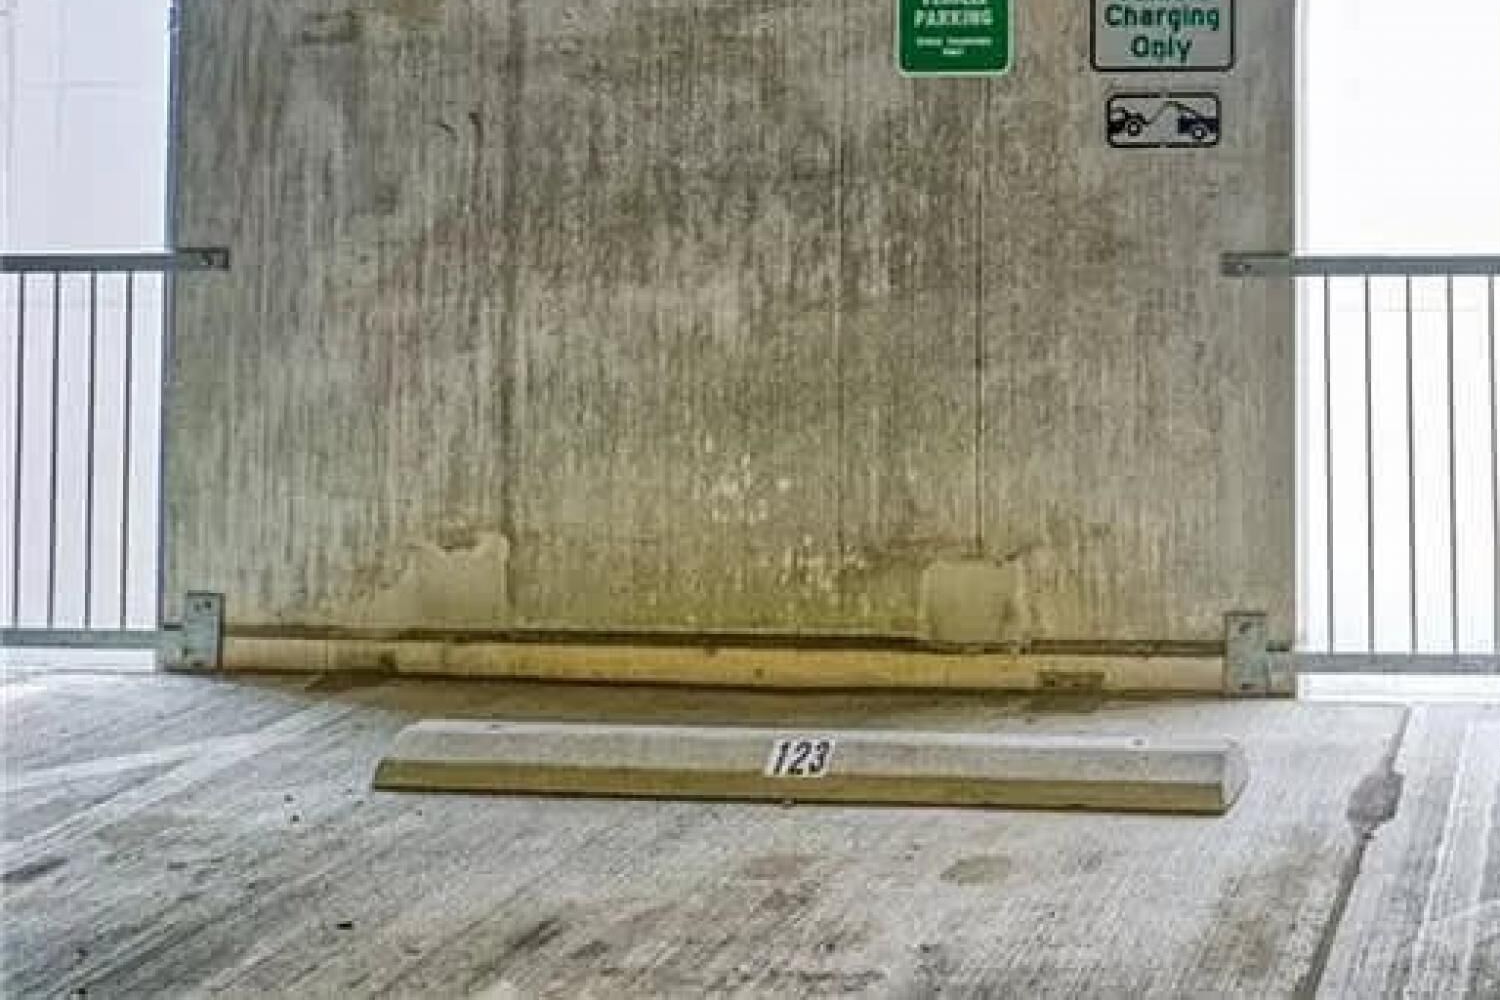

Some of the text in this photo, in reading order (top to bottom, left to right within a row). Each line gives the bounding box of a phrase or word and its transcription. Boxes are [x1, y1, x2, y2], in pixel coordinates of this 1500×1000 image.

[914, 9, 993, 26] PARKING
[1104, 5, 1220, 31] Charging
[1131, 35, 1192, 63] Only
[774, 741, 830, 775] 123
